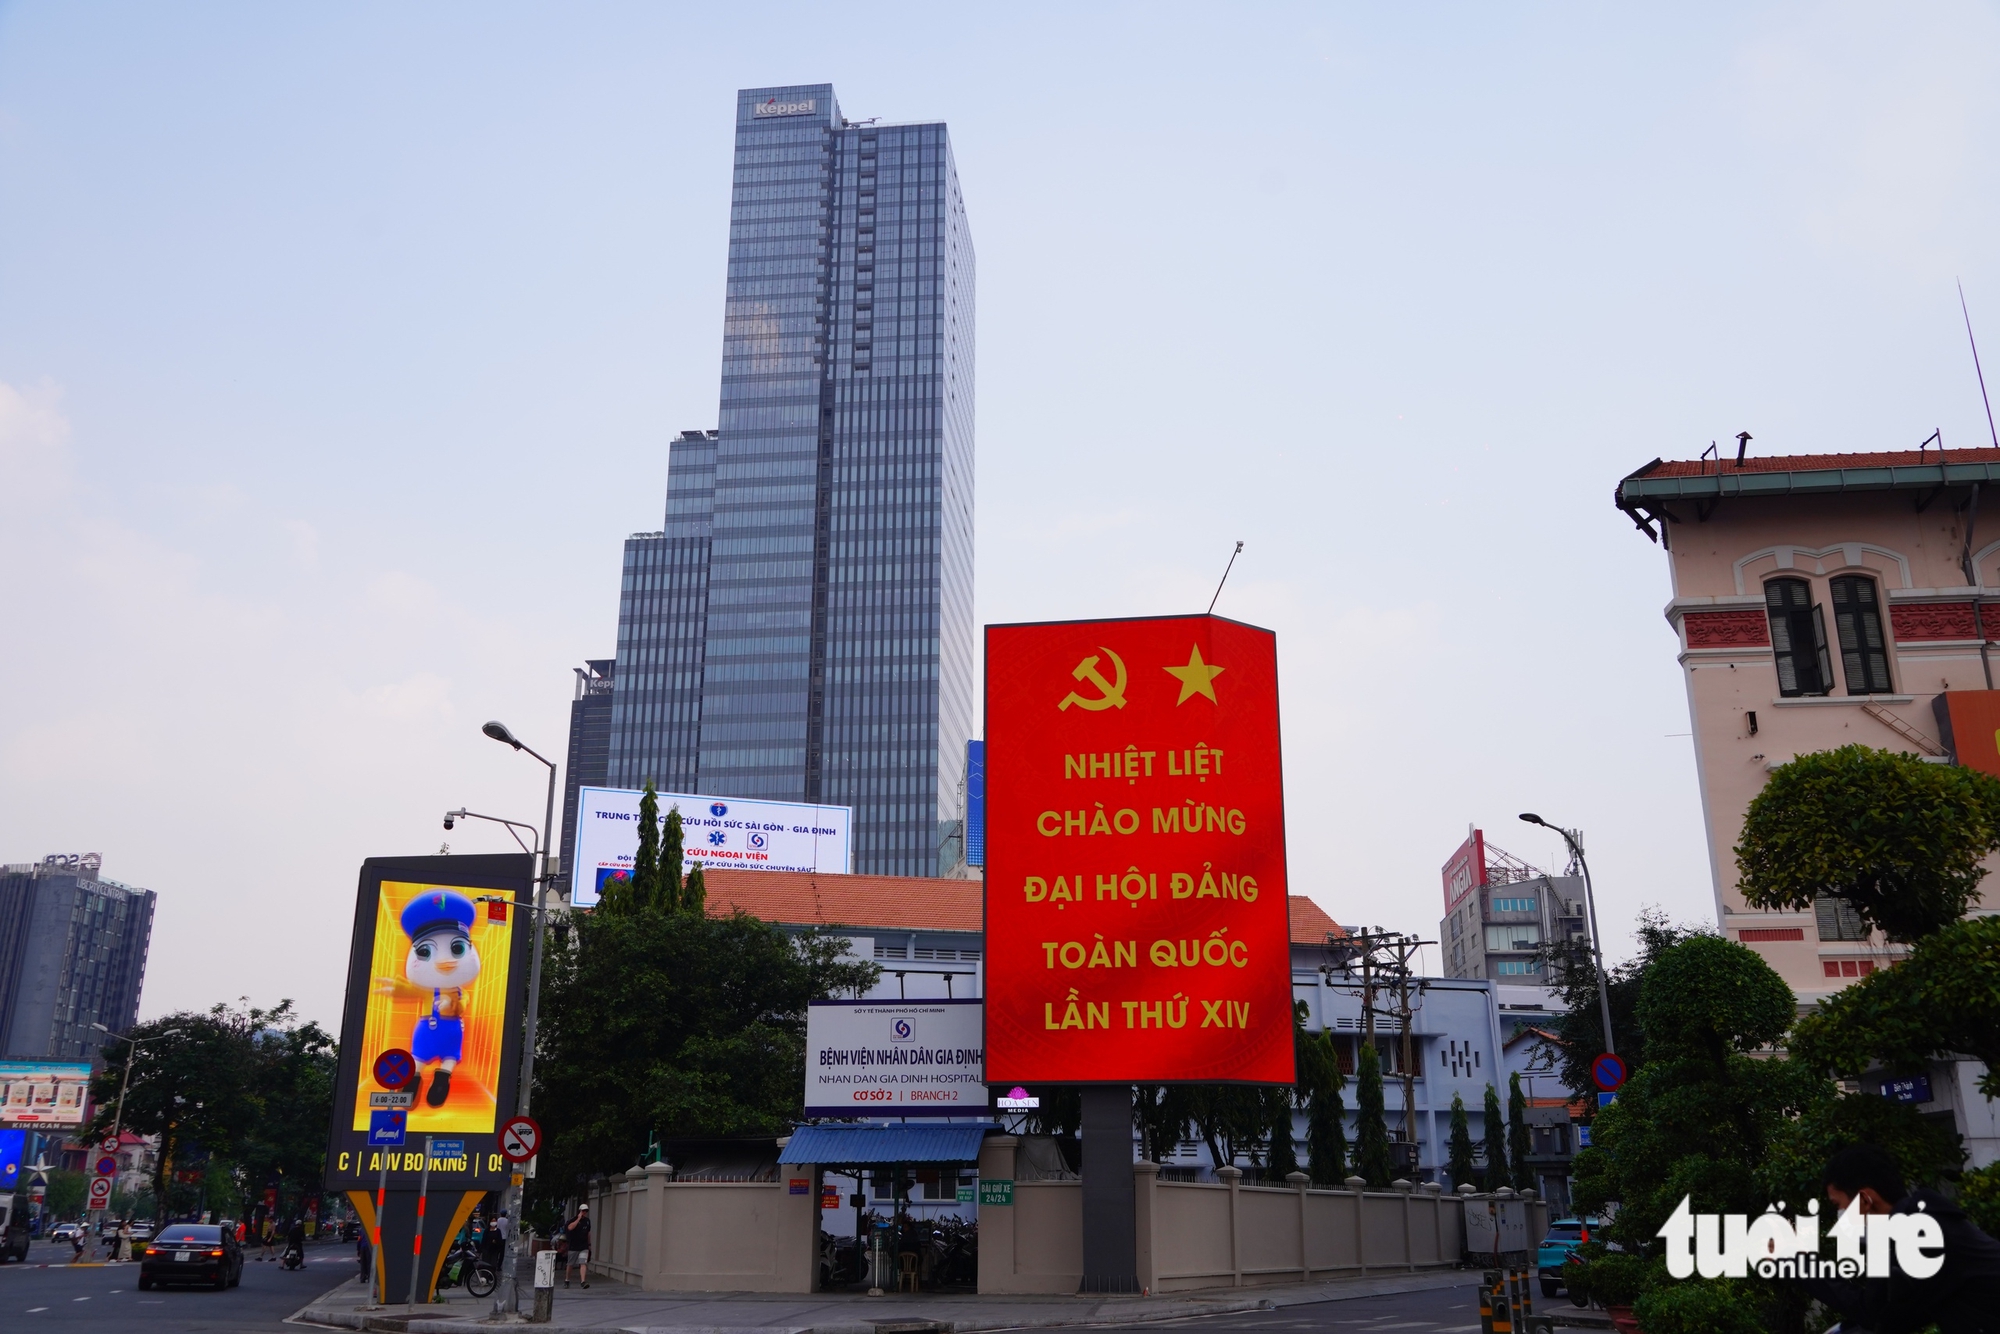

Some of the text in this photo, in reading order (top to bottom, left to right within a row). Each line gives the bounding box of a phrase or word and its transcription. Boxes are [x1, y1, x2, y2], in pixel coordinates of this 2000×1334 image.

[755, 98, 814, 116] Keppel
[1064, 742, 1224, 785] NHIỆT LIỆT
[595, 811, 630, 821] TRUNG
[703, 817, 721, 828] HỒI
[724, 819, 743, 829] SỨC
[745, 820, 760, 830] SÀI
[763, 822, 784, 832] GÒN
[792, 826, 809, 834] GIA
[811, 827, 836, 836] ĐỊNH
[1036, 799, 1246, 837] CHÀO MỪNG
[686, 847, 768, 861] CỨU NGOẠI VIỆN
[749, 862, 764, 870] SỨC
[766, 864, 795, 872] CHUYÊN
[76, 878, 126, 901] LIBERTY CENTRAL
[1024, 861, 1258, 909] ĐẠI HỘI ĐẢNG
[1042, 927, 1248, 969] TOÀN QUỐC
[1045, 987, 1250, 1030] LẦN THỨ XIV
[820, 1046, 982, 1069] BỆNH VIỆN NHÂN DÂN GIA ĐỊNH
[819, 1074, 982, 1083] NHAN DAN GIA DINH HOSPITAL
[853, 1090, 868, 1101] CƠ
[870, 1088, 885, 1101] SỞ
[886, 1091, 892, 1100] 2
[911, 1091, 950, 1101] BRANCH
[952, 1091, 958, 1100] 2
[998, 1099, 1038, 1107] HOA SEN
[981, 1182, 1011, 1193] BÃI GIỮ XE
[986, 1194, 1006, 1203] 24/24
